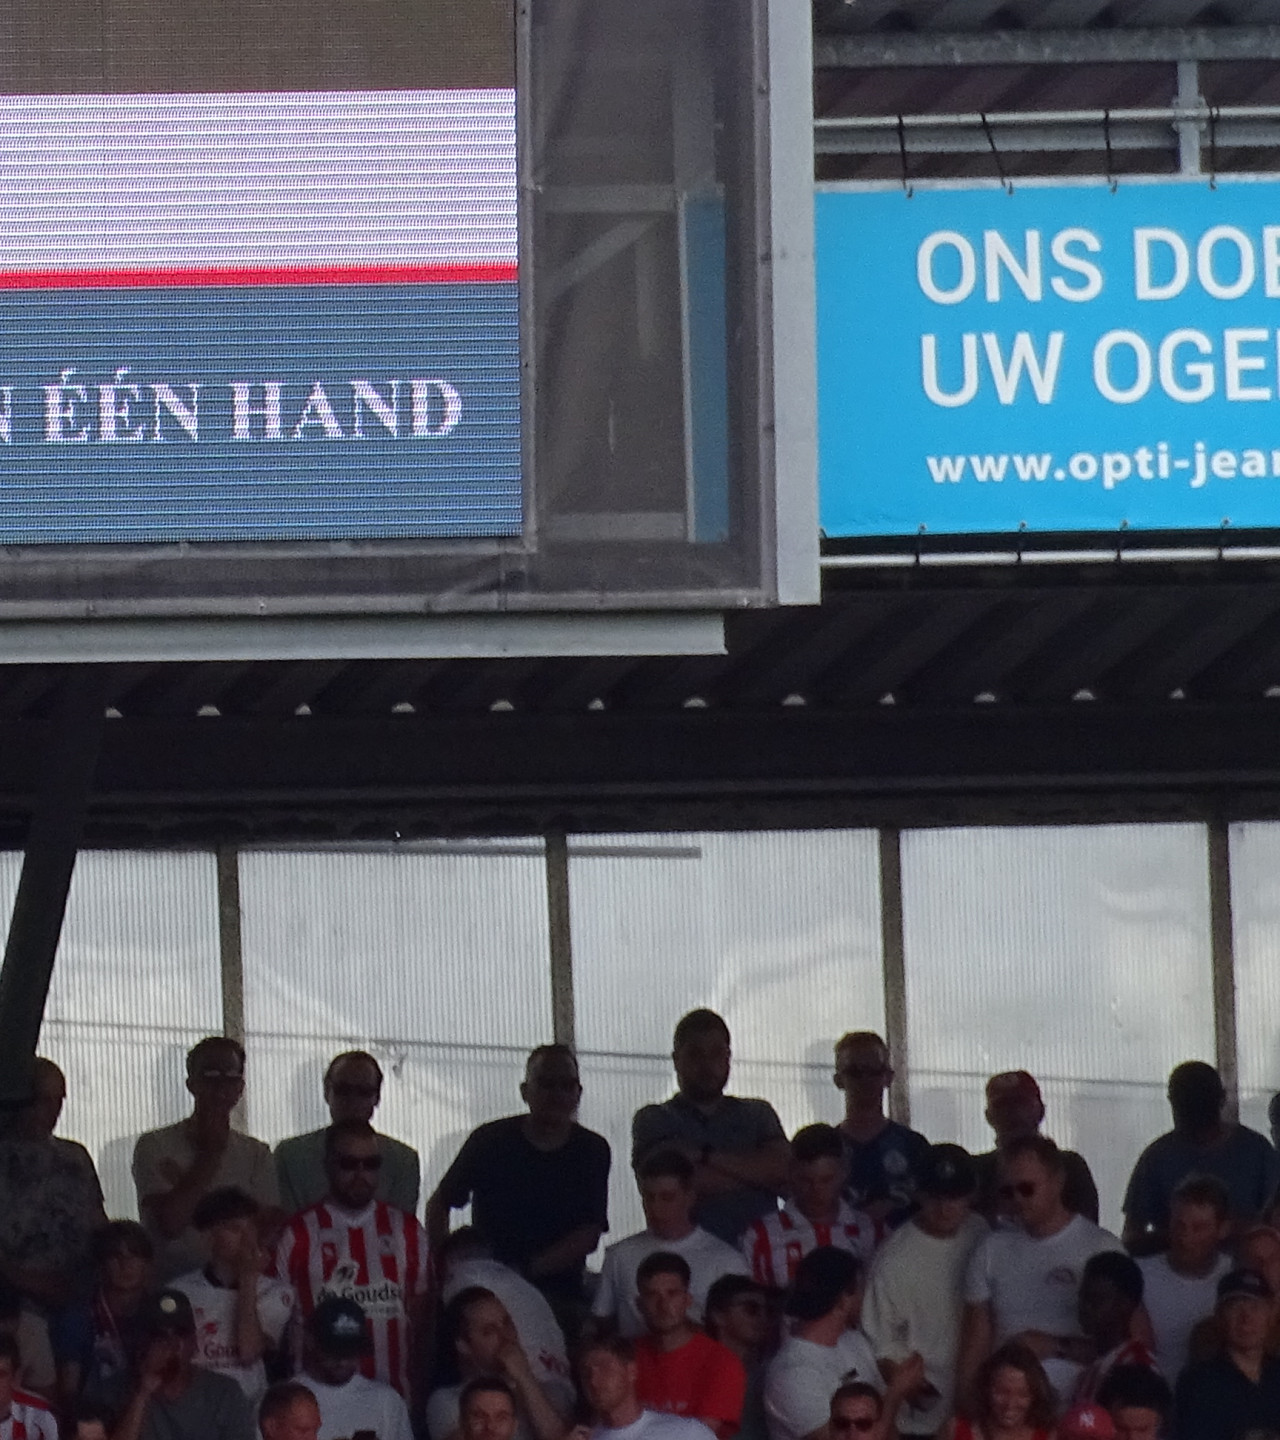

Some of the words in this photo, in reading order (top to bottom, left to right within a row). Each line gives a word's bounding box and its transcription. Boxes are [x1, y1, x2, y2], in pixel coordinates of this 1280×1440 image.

[916, 227, 1105, 306] ONS
[40, 367, 202, 444] ÉÉN
[229, 378, 464, 442] HAND
[921, 331, 1065, 408] UW
[1093, 327, 1280, 405] OGE
